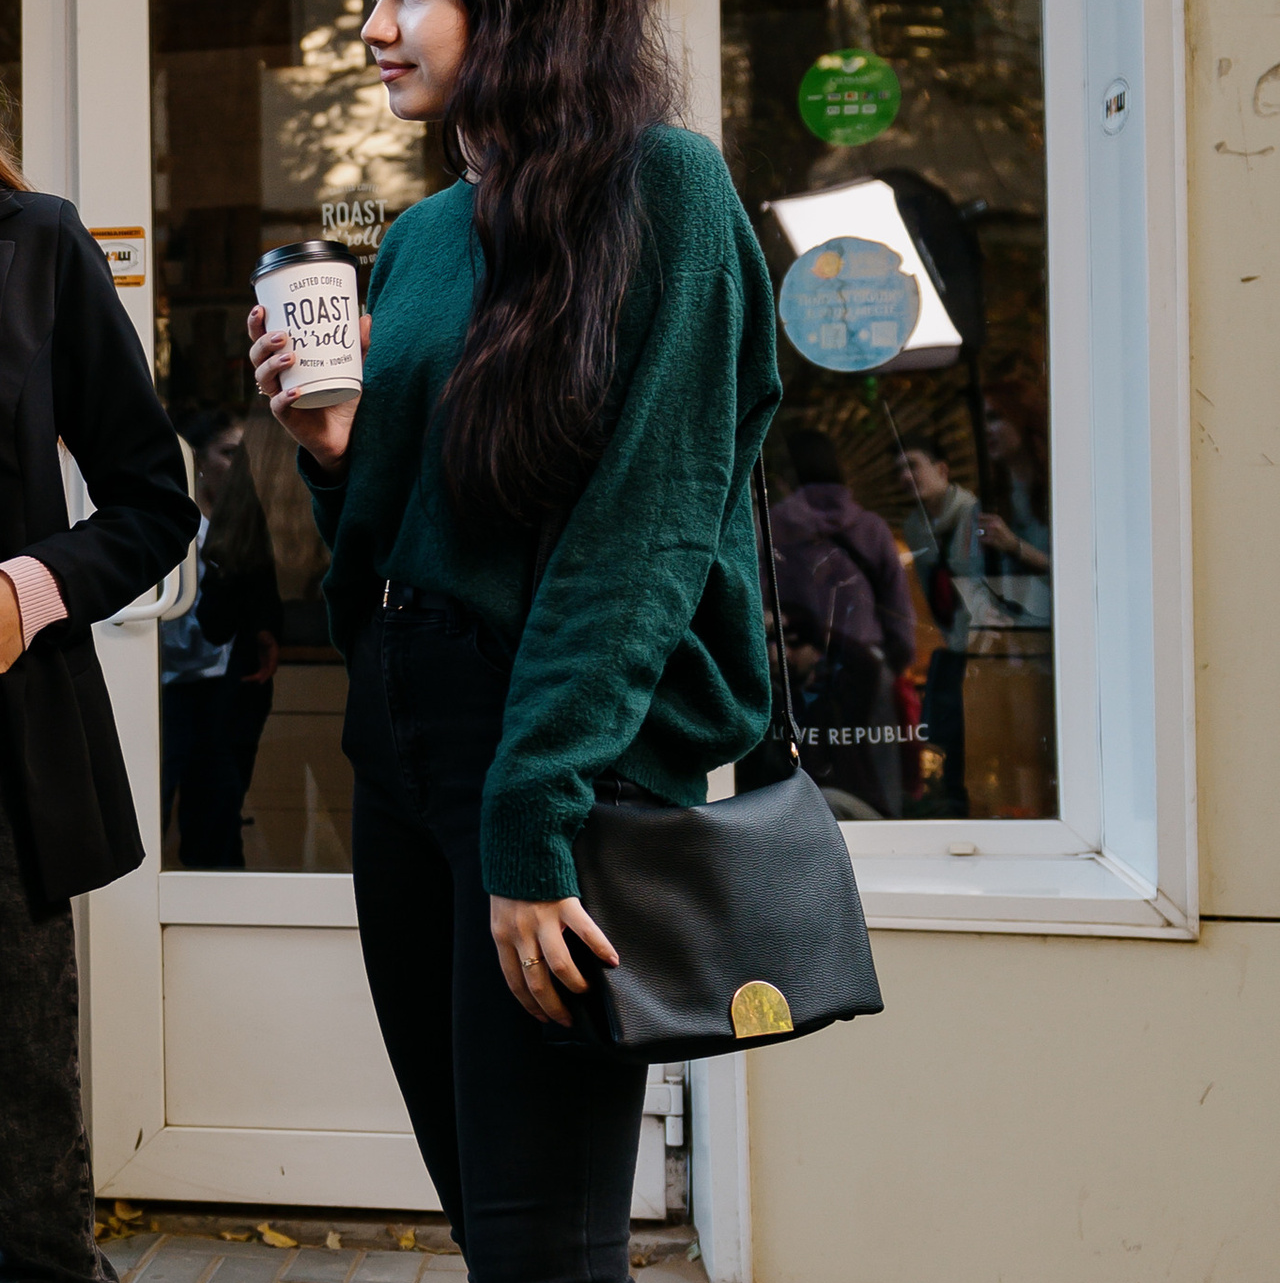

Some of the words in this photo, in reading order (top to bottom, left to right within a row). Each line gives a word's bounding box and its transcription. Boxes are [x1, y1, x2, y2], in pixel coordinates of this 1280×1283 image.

[322, 199, 388, 230] ROAST
[289, 277, 319, 293] CRAFTED
[320, 276, 343, 288] COFFEE
[283, 296, 350, 330] ROAST
[828, 723, 929, 745] REPUBLIC
